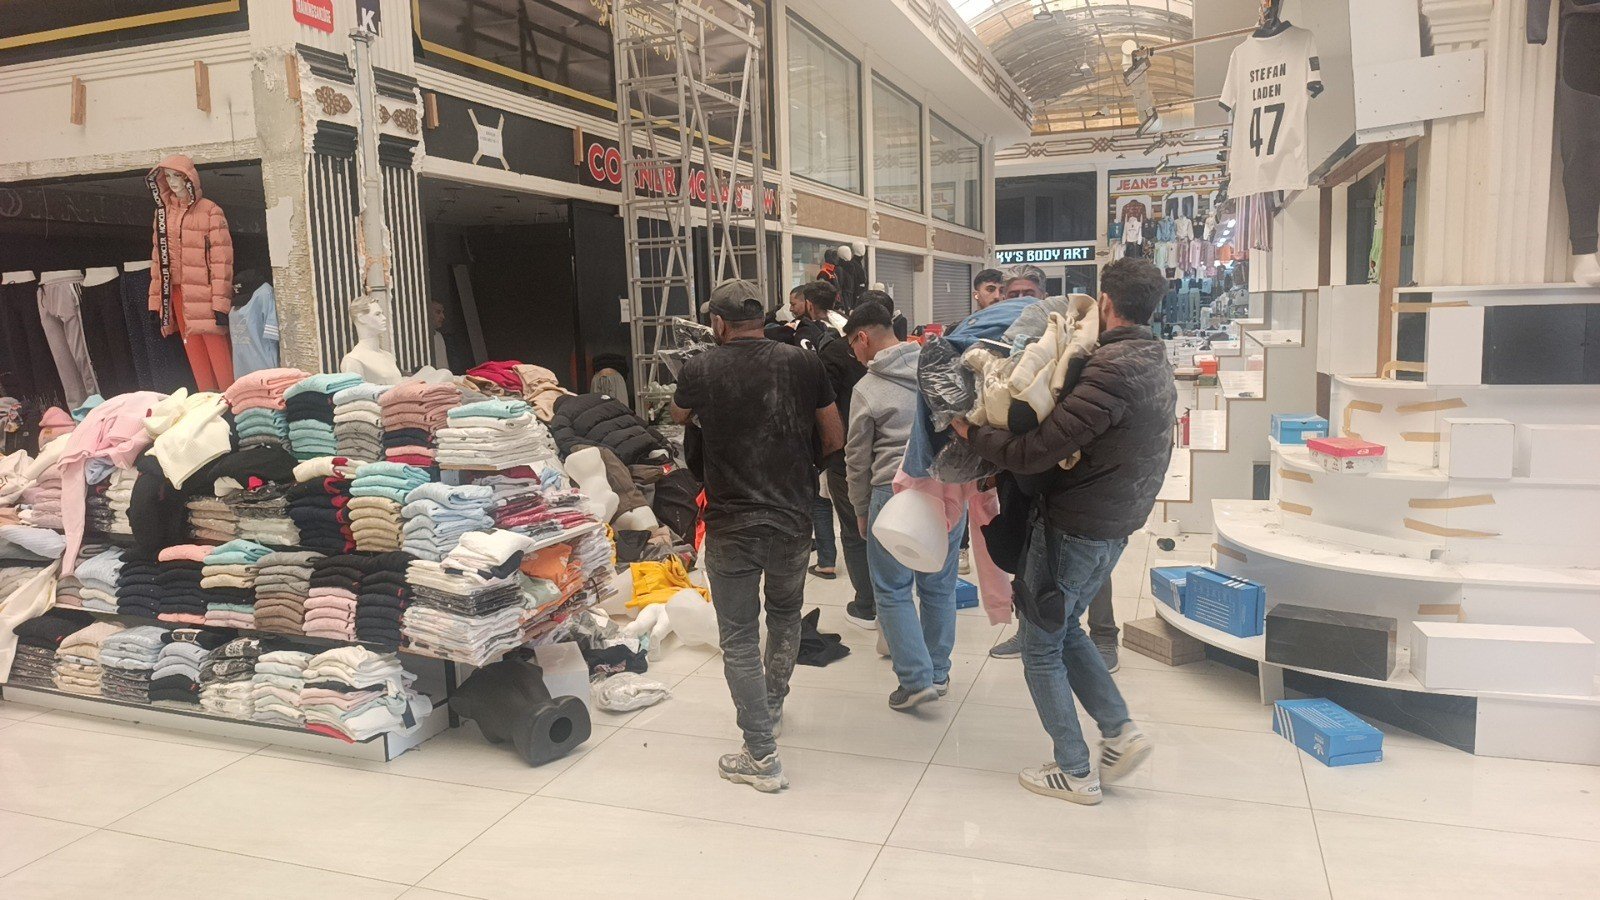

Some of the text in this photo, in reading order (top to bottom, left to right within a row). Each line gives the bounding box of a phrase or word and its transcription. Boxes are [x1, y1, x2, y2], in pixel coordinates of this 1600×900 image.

[1250, 63, 1286, 83] STEFAN
[1253, 83, 1281, 101] LADEN
[1249, 102, 1285, 157] 47
[1116, 177, 1158, 191] JEANS
[1160, 177, 1169, 188] &
[1026, 249, 1060, 262] BODY
[1063, 247, 1090, 260] ART
